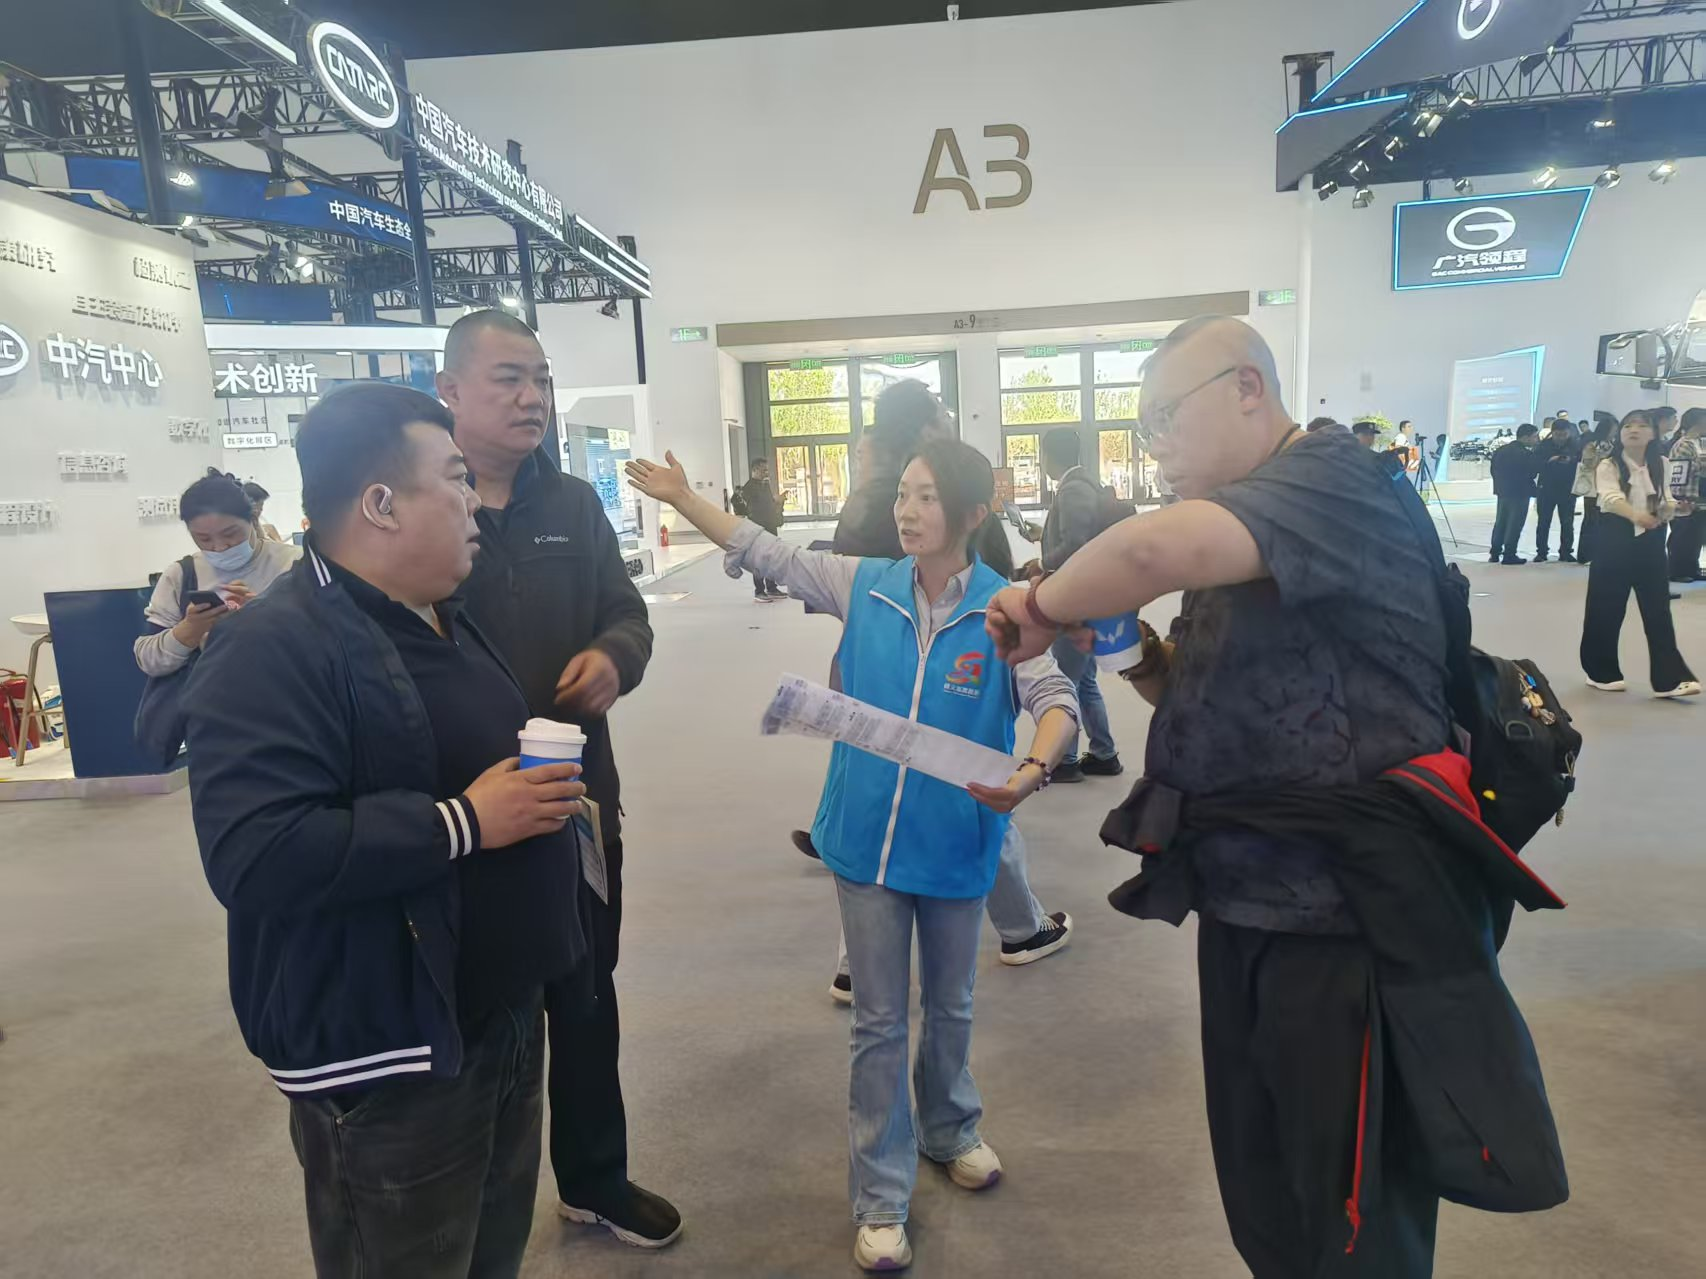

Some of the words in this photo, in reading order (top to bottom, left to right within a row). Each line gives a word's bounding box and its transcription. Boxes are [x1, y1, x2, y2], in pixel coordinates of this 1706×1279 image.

[415, 92, 564, 225] 中国汽车技术研究中心有限公司
[912, 123, 1033, 214] A3
[46, 332, 163, 388] 中汽中心
[215, 362, 319, 394] 术创新
[540, 534, 569, 543] Columbia
